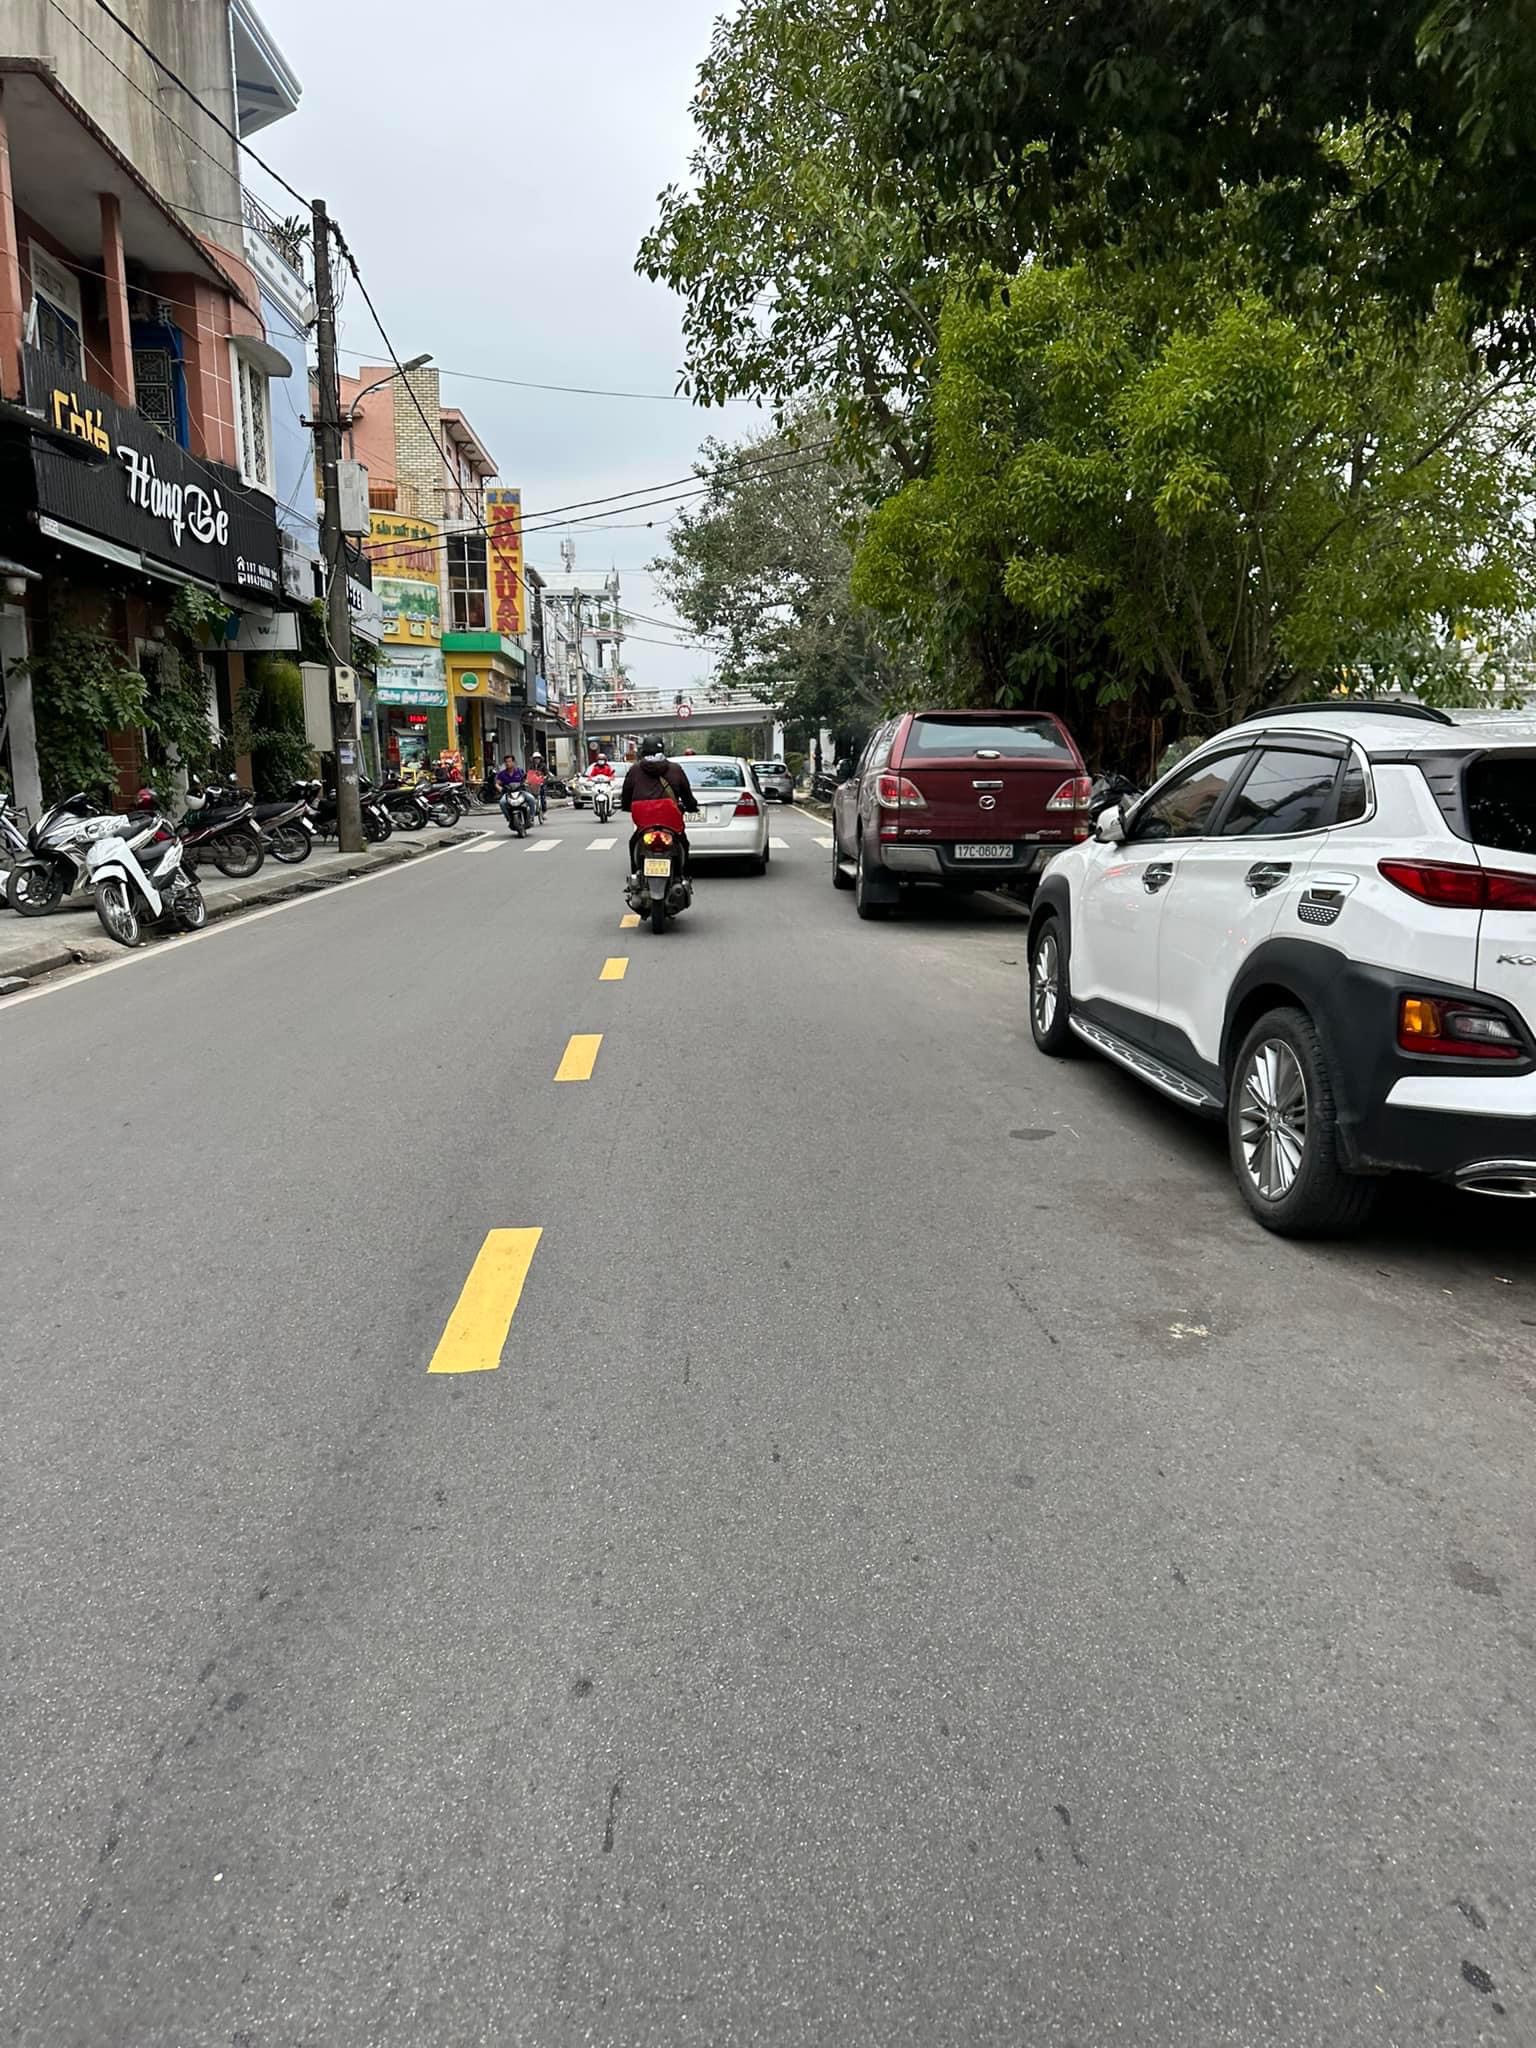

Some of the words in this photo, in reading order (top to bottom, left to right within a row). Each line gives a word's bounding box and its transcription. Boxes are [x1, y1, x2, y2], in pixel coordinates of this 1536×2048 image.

[117, 444, 186, 547] Hàng
[185, 484, 229, 546] Bè
[490, 506, 519, 555] NAM
